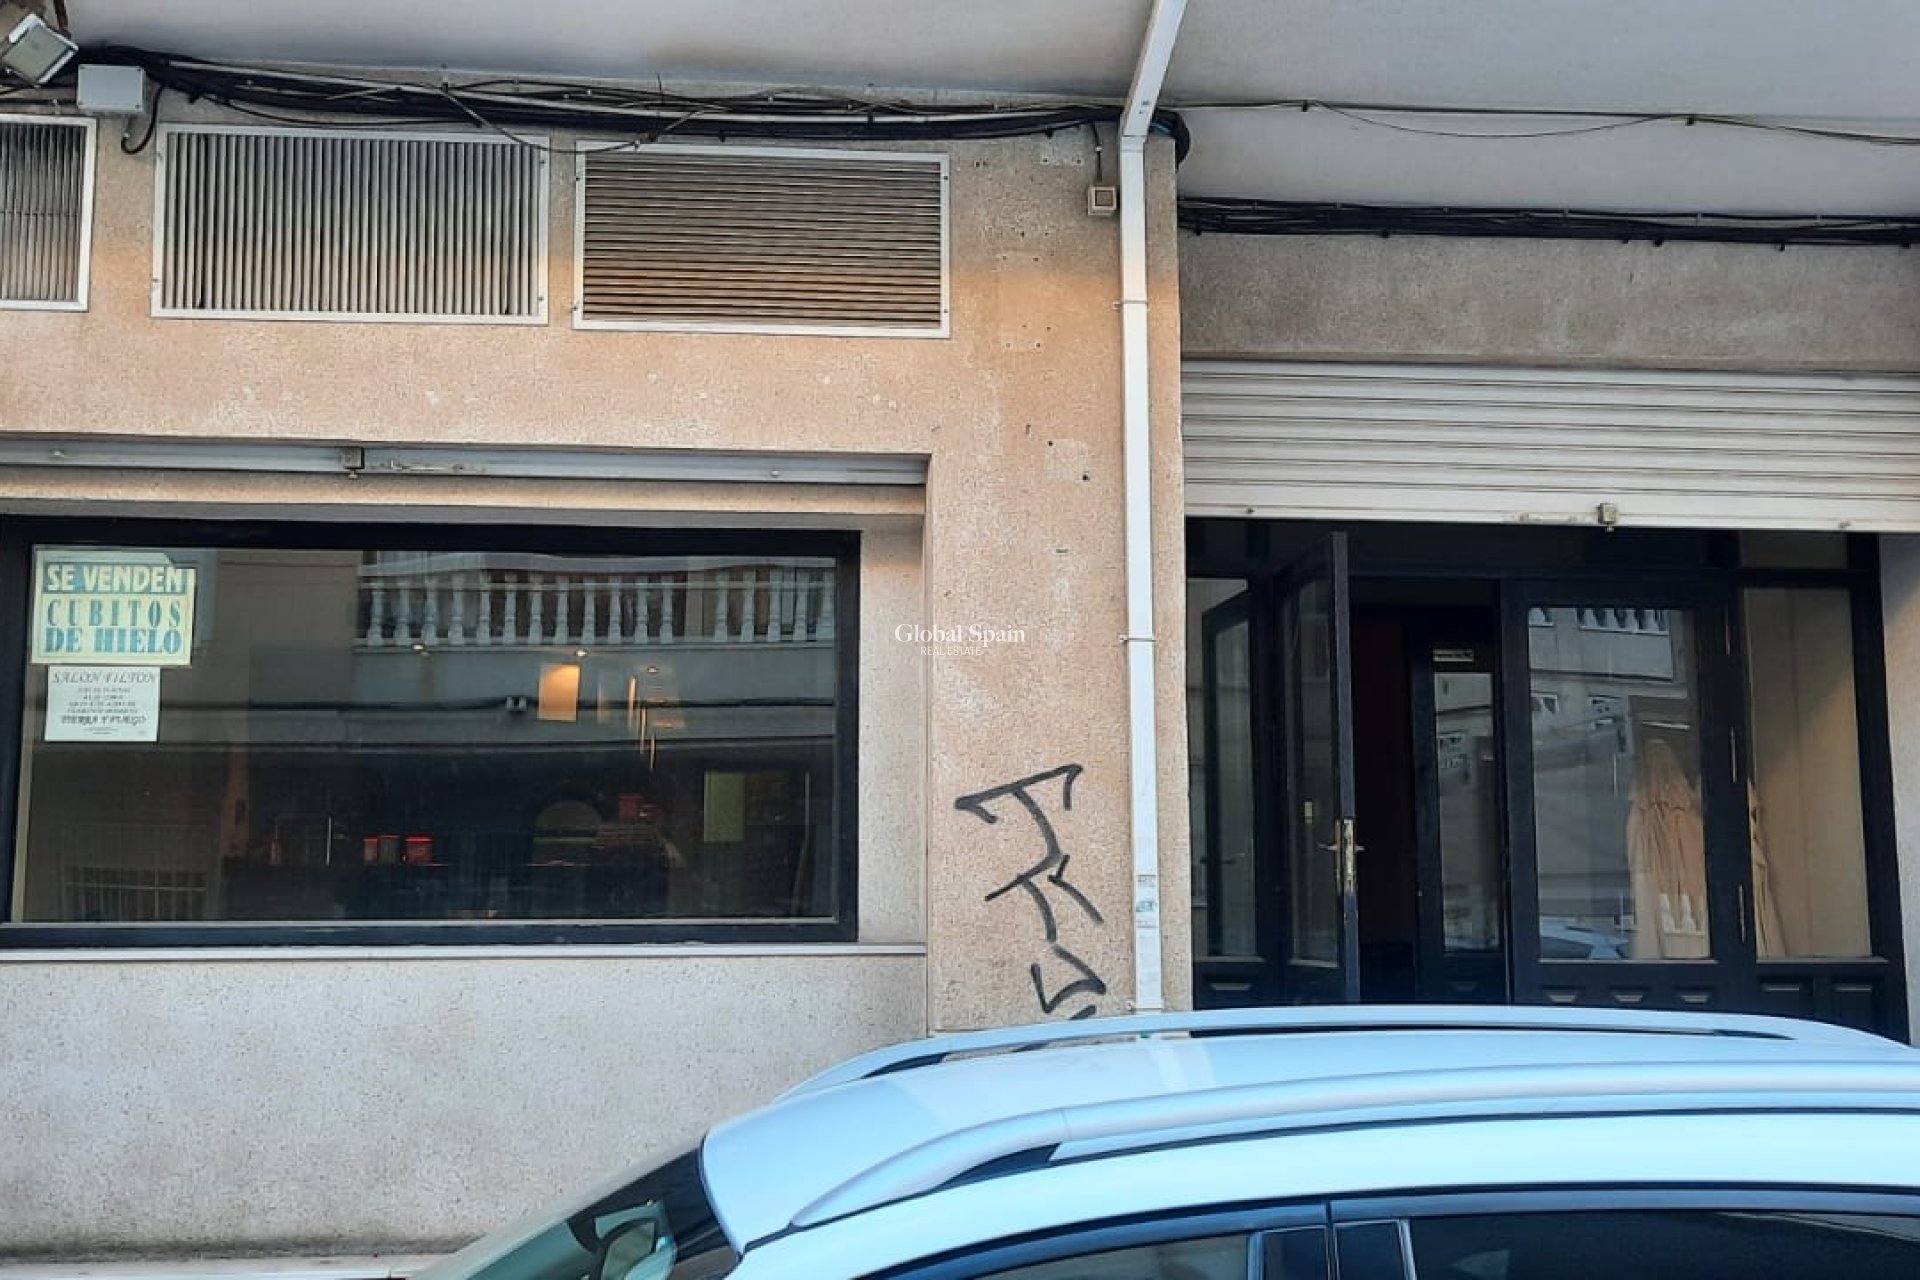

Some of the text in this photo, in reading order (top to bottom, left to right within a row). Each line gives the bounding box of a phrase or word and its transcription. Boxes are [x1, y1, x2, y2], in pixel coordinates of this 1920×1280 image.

[47, 564, 183, 593] SE VENDEN
[47, 598, 181, 628] CUBITOS
[45, 627, 182, 654] DE HIELO
